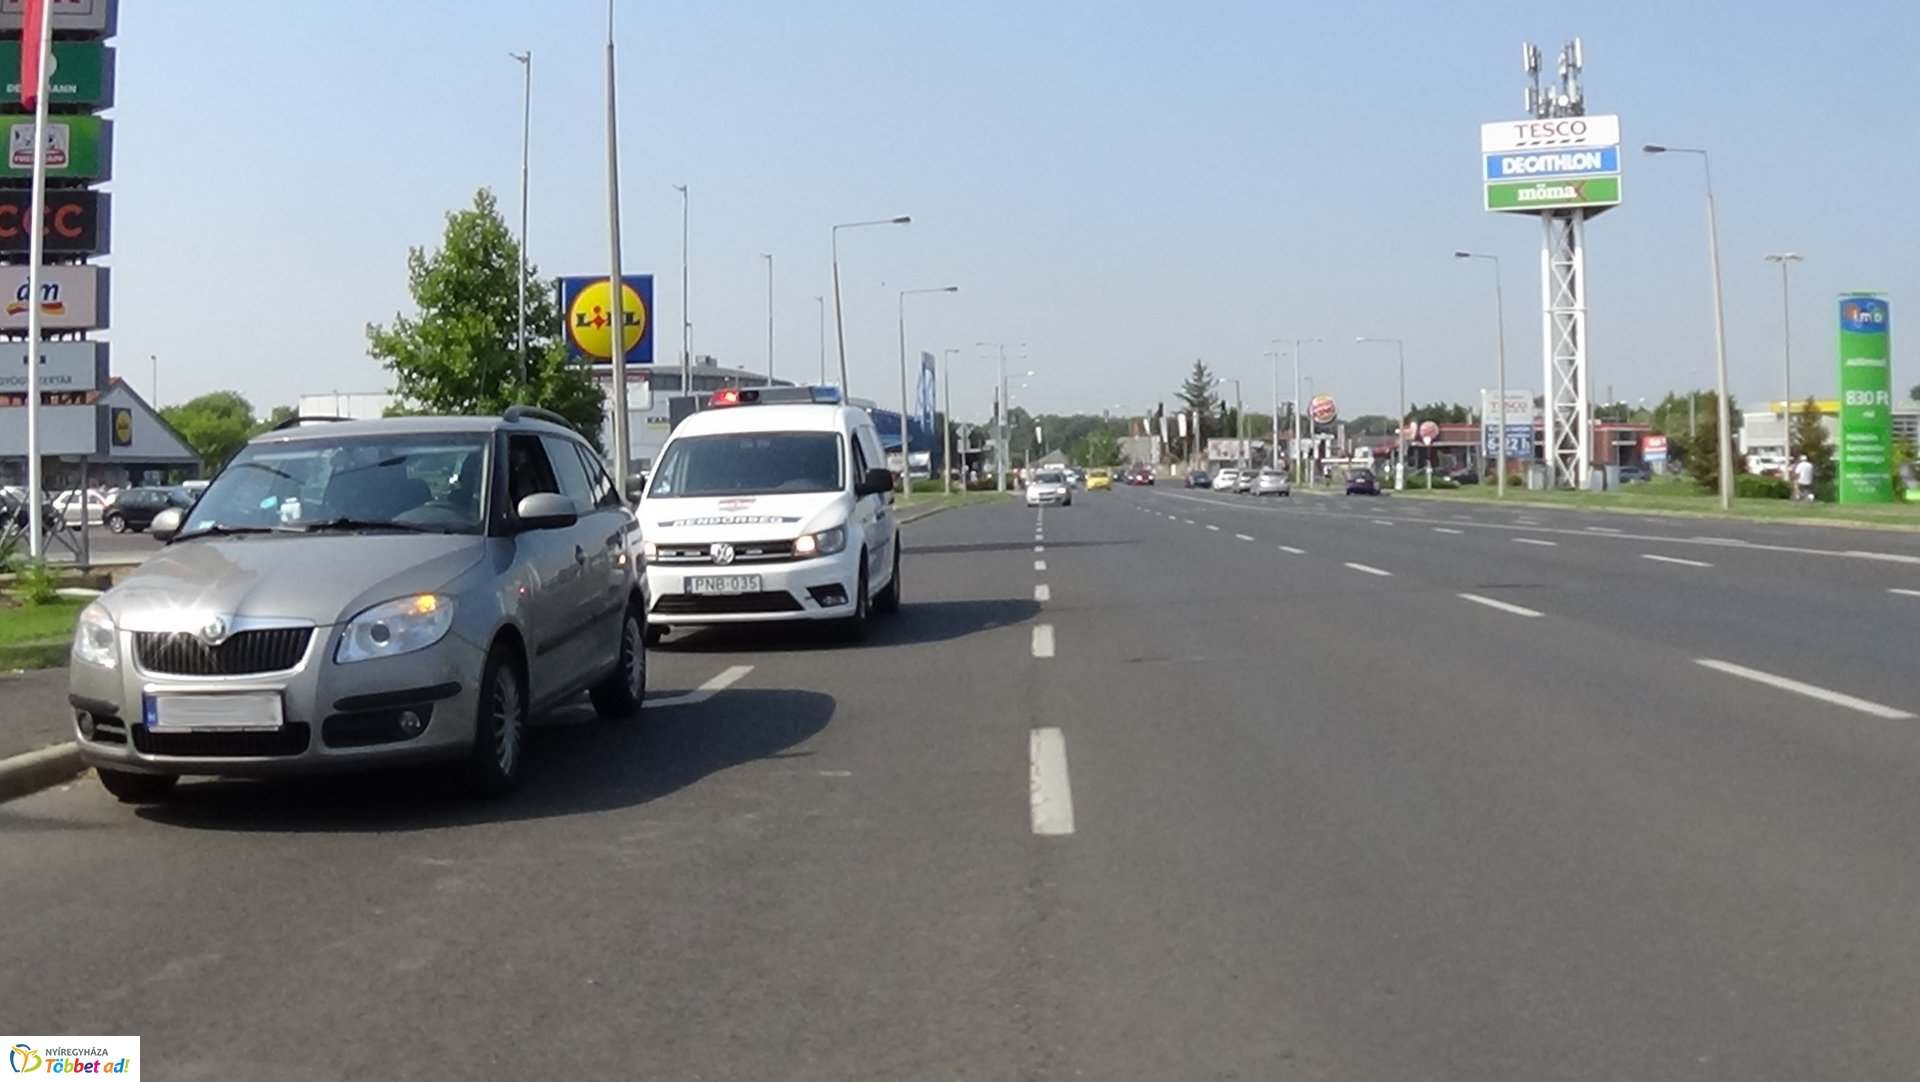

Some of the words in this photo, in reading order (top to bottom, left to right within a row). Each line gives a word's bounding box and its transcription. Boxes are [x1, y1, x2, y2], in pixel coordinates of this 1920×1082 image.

[1514, 121, 1587, 139] TESCO
[1502, 152, 1602, 174] DECATHLON
[1846, 390, 1874, 406] 830
